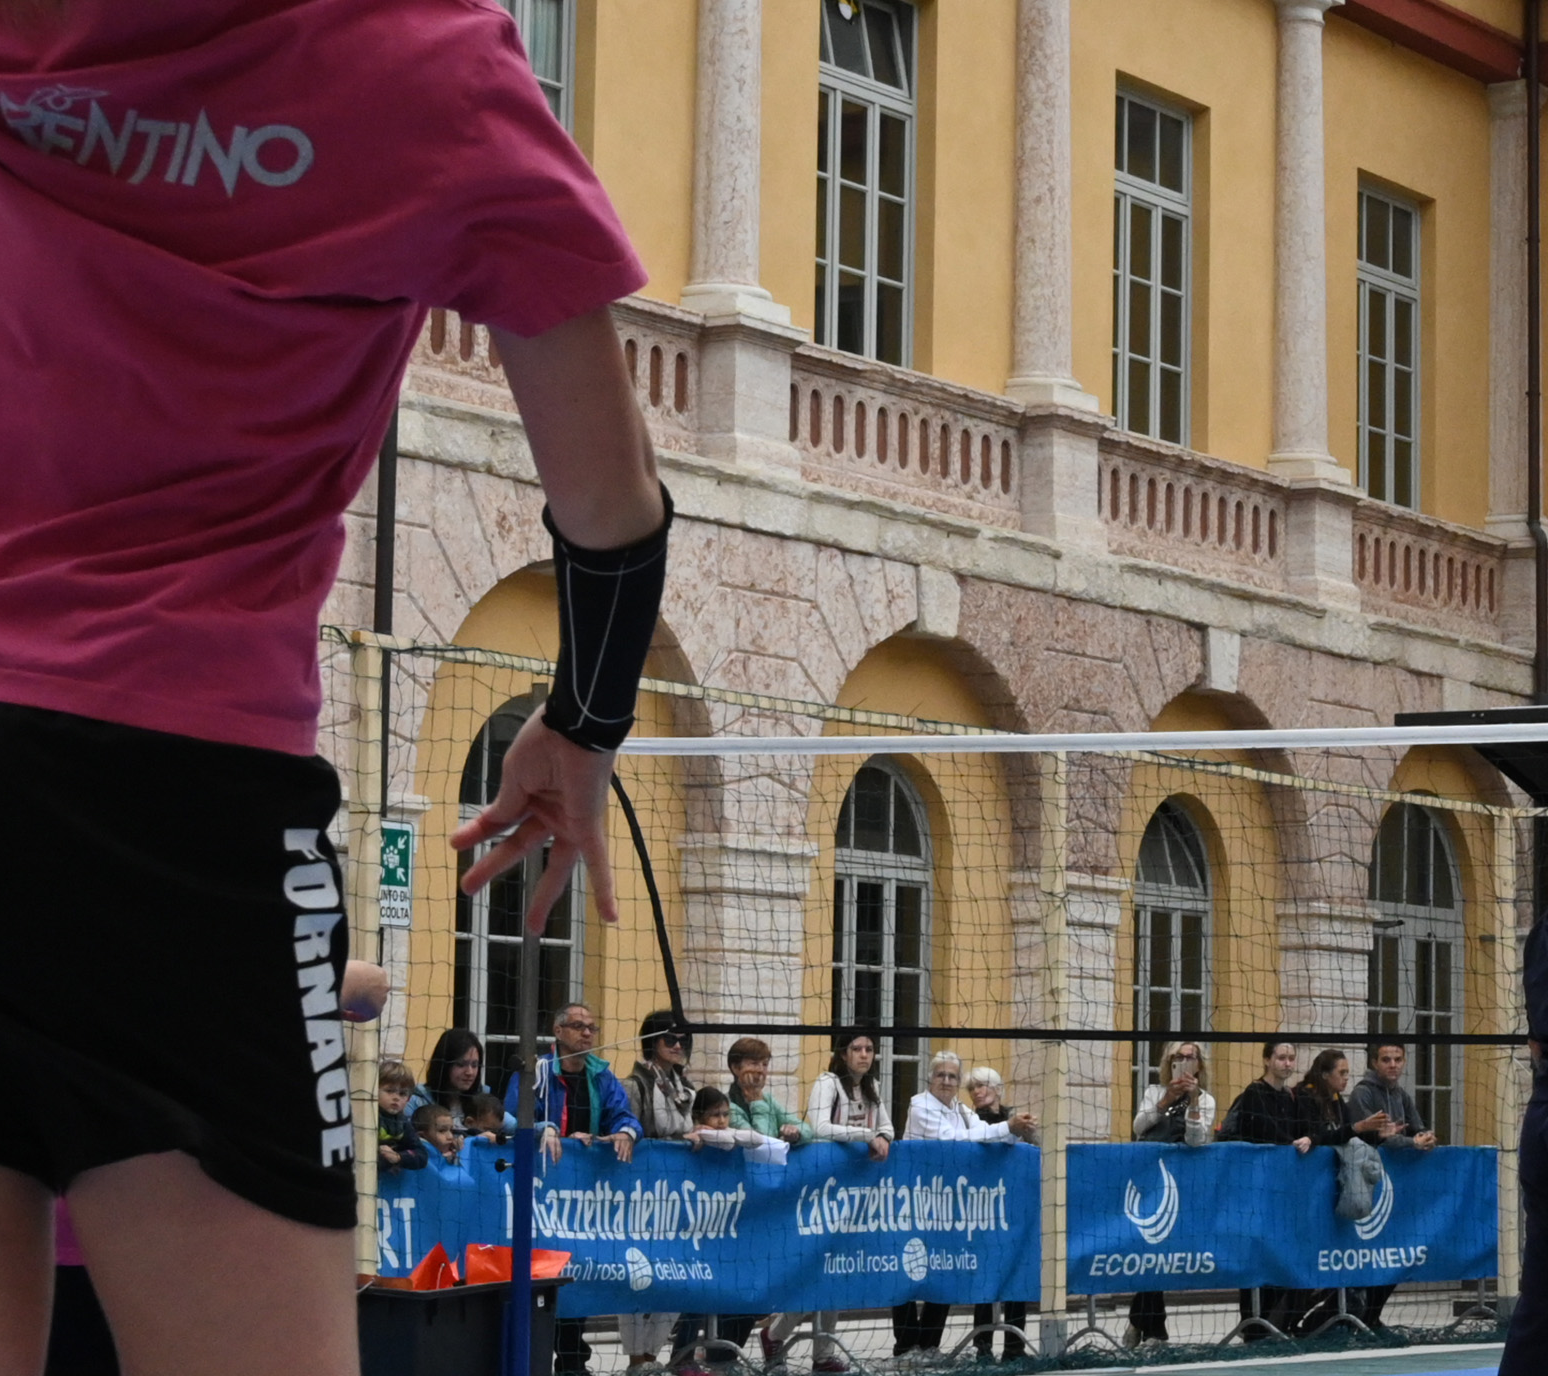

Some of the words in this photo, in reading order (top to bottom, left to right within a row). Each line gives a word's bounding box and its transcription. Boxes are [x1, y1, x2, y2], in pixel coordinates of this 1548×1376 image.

[627, 1179, 681, 1239] dello
[679, 1179, 747, 1251] Sport
[822, 1176, 912, 1234] Gazzetta
[913, 1175, 954, 1232] dello
[955, 1175, 1009, 1242] Sport
[581, 1257, 592, 1281] il
[594, 1259, 626, 1282] rosa
[655, 1257, 689, 1281] della
[688, 1259, 714, 1280] vita
[823, 1252, 856, 1275] Tutto
[856, 1250, 865, 1273] il
[867, 1256, 899, 1272] rosa
[929, 1248, 954, 1271] della
[955, 1247, 978, 1270] vita
[1089, 1252, 1216, 1276] ECOPNEUS
[1318, 1246, 1429, 1272] ECOPNEUS
